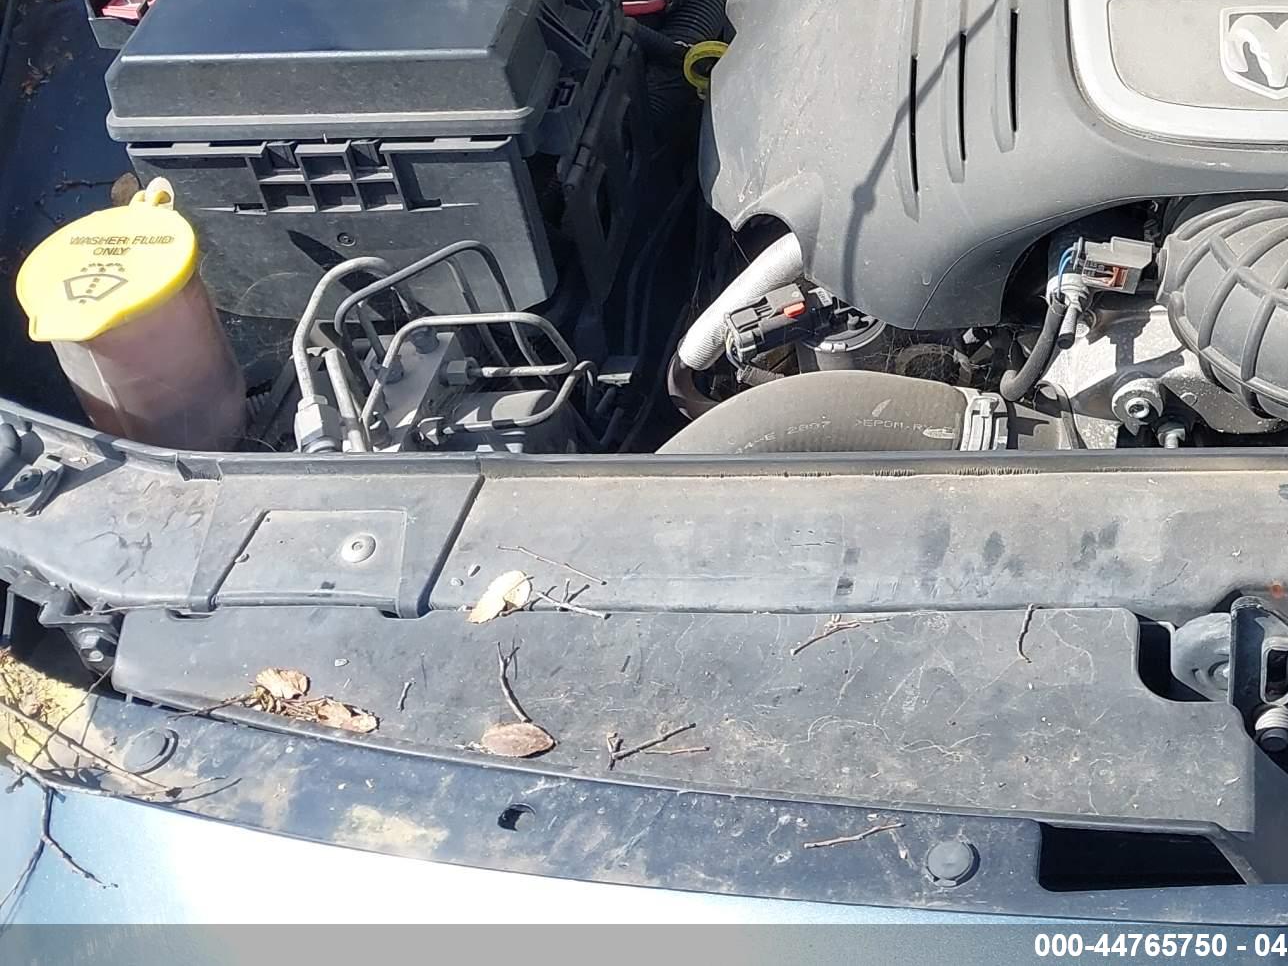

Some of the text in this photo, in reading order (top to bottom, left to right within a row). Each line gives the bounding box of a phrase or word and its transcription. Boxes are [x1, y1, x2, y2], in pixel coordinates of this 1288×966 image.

[69, 235, 174, 245] WASHER FLUID
[92, 246, 129, 256] ONLY
